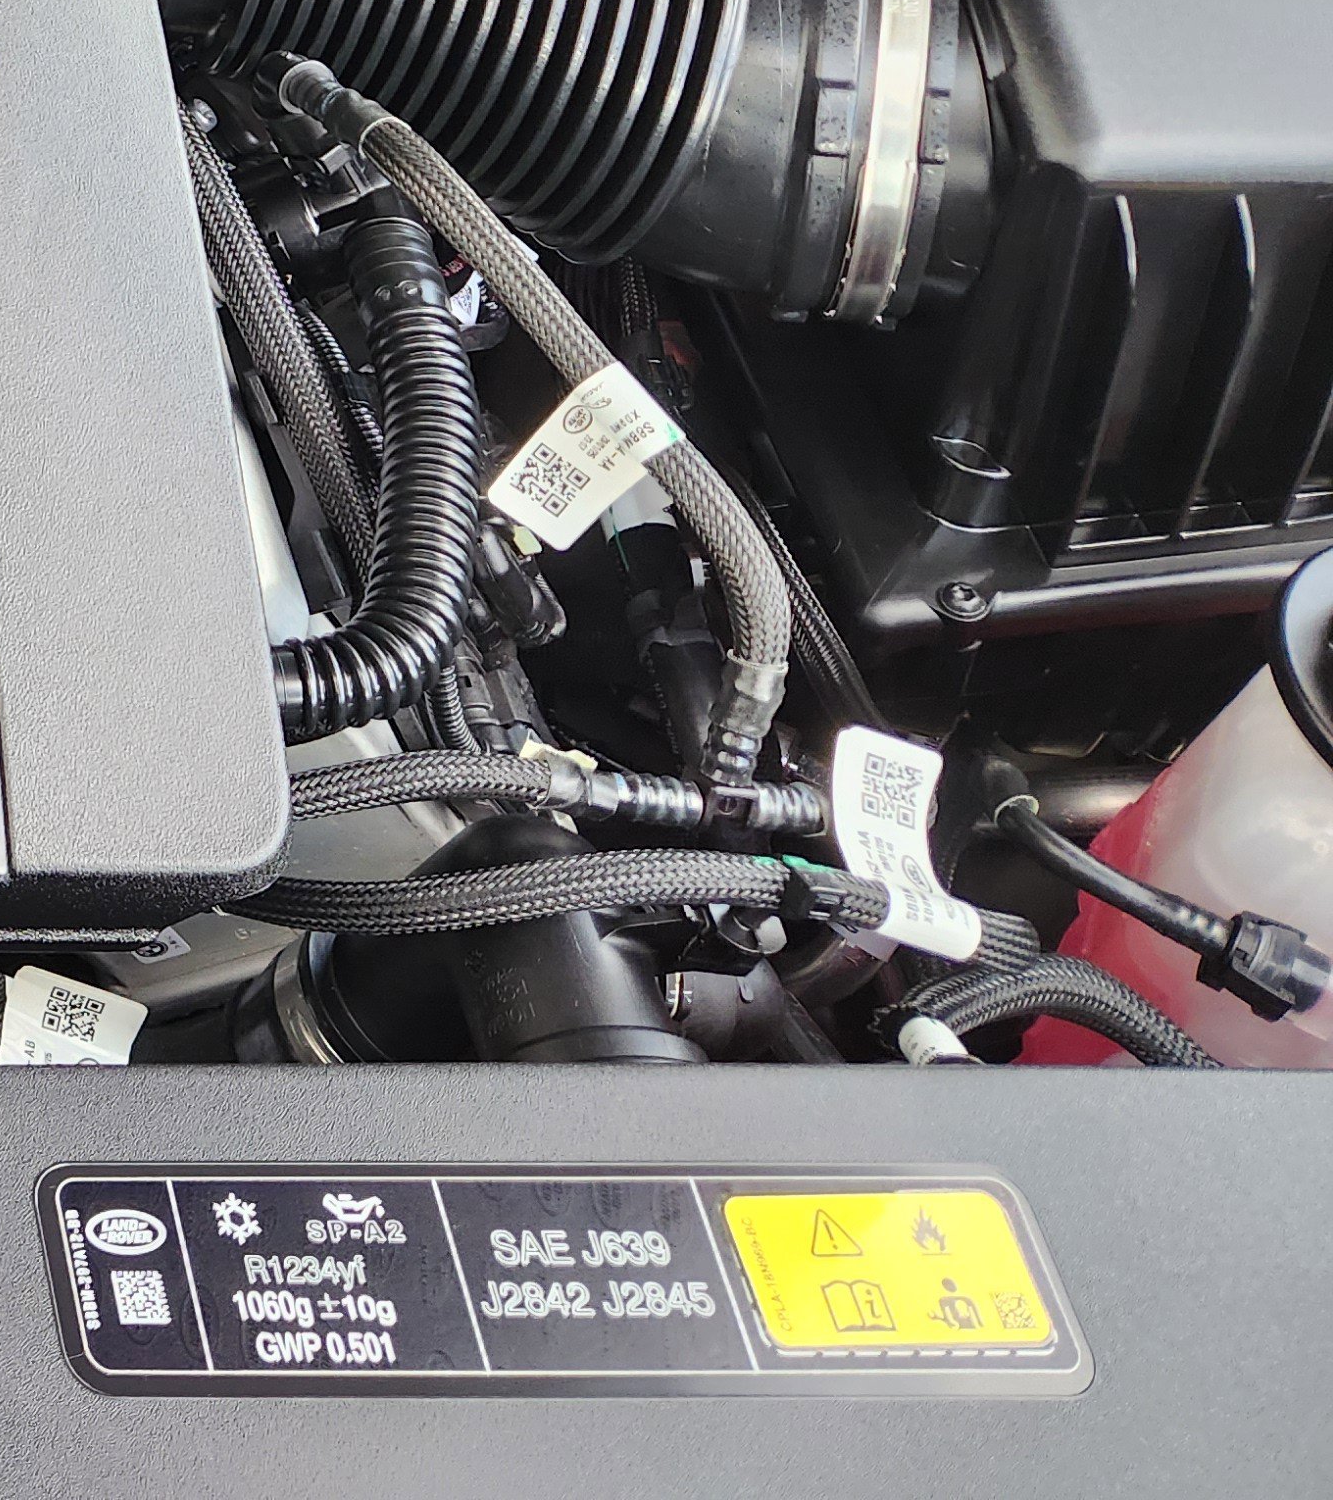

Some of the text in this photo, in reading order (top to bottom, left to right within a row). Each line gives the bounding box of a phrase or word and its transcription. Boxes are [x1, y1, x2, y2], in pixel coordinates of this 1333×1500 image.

[305, 1219, 407, 1244] SP-A2
[490, 1229, 671, 1267] SAE J639
[244, 1254, 366, 1292] R1234yf
[232, 1290, 315, 1328] 1060g
[481, 1280, 716, 1319] J2842 J2845
[255, 1331, 397, 1364] GWP 0.501
